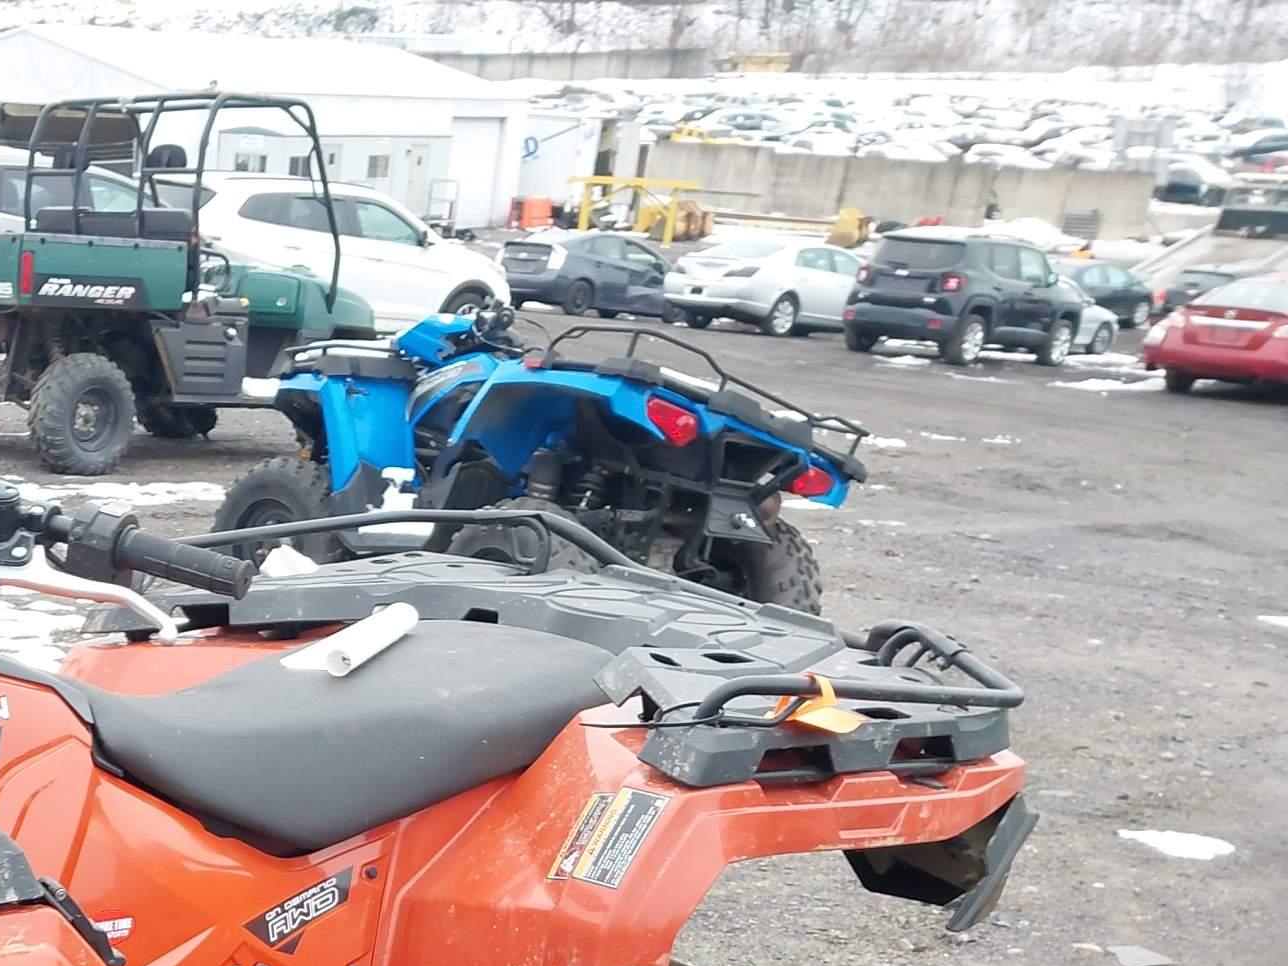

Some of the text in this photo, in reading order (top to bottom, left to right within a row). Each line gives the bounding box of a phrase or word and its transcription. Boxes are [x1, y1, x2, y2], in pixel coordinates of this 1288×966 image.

[38, 282, 136, 299] RANGER
[592, 809, 618, 850] WARNING
[268, 887, 339, 942] AWD
